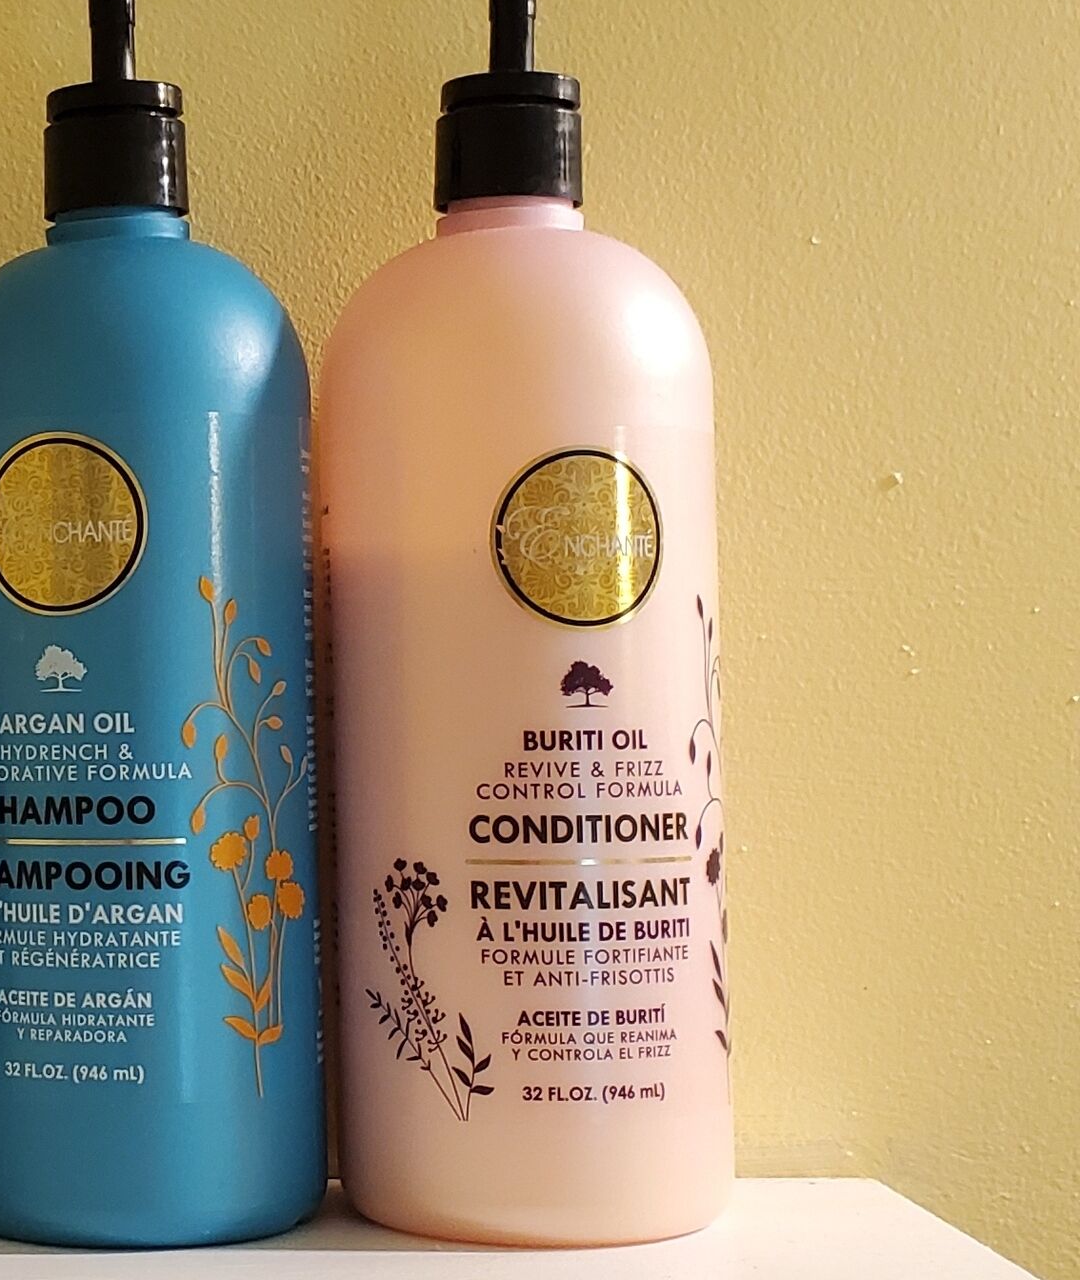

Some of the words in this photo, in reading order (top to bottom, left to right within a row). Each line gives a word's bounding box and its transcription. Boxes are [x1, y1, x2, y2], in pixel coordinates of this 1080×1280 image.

[0, 713, 85, 734] ARGAN
[94, 712, 135, 734] OIL
[523, 730, 603, 751] BURITI
[612, 729, 648, 750] OIL
[0, 744, 108, 761] HYDRENCH
[119, 743, 133, 760] &
[87, 762, 193, 781] FORMULA
[504, 761, 581, 778] REVIVE
[591, 761, 605, 778] &
[615, 760, 663, 777] FRIZZ
[476, 783, 586, 800] CONTROL
[596, 780, 683, 798] FORMULA
[469, 812, 689, 844] CONDITIONER
[470, 877, 691, 911] REVITALISANT
[68, 902, 184, 925] D'ARGAN
[53, 930, 182, 948] HYDRATANTE
[476, 916, 494, 942] À
[503, 920, 590, 942] L'HUILE
[599, 921, 627, 942] DE
[634, 917, 690, 940] BURITI
[12, 947, 160, 968] RÉGÉNÉRATRICE
[481, 949, 575, 965] FORMULE
[584, 945, 689, 964] FORTIFIANTE
[504, 970, 524, 986] ET
[533, 967, 675, 987] ANTI-FRISOTTIS
[54, 992, 76, 1008] DE
[81, 988, 152, 1009] ARGÁN
[62, 1012, 156, 1028] HIDRATANTE
[517, 1010, 581, 1027] ACEITE
[588, 1010, 610, 1026] DE
[616, 1003, 666, 1025] BURITÍ
[16, 1028, 25, 1040] Y
[30, 1028, 128, 1044] REPARADORA
[502, 1029, 577, 1045] FÓRMULA
[583, 1032, 615, 1046] QUE
[620, 1028, 678, 1044] REANIMA
[512, 1048, 521, 1061] Y
[528, 1048, 614, 1062] CONTROLA
[620, 1048, 633, 1060] EL
[638, 1044, 672, 1059] FRIZZ
[5, 1061, 20, 1078] 32
[24, 1062, 68, 1081] FL.OZ.
[72, 1064, 108, 1084] (946
[113, 1065, 145, 1084] mL)
[522, 1086, 543, 1102] 32
[548, 1086, 598, 1102] FL.OZ.
[602, 1084, 636, 1104] (946
[640, 1082, 666, 1101] mL)
